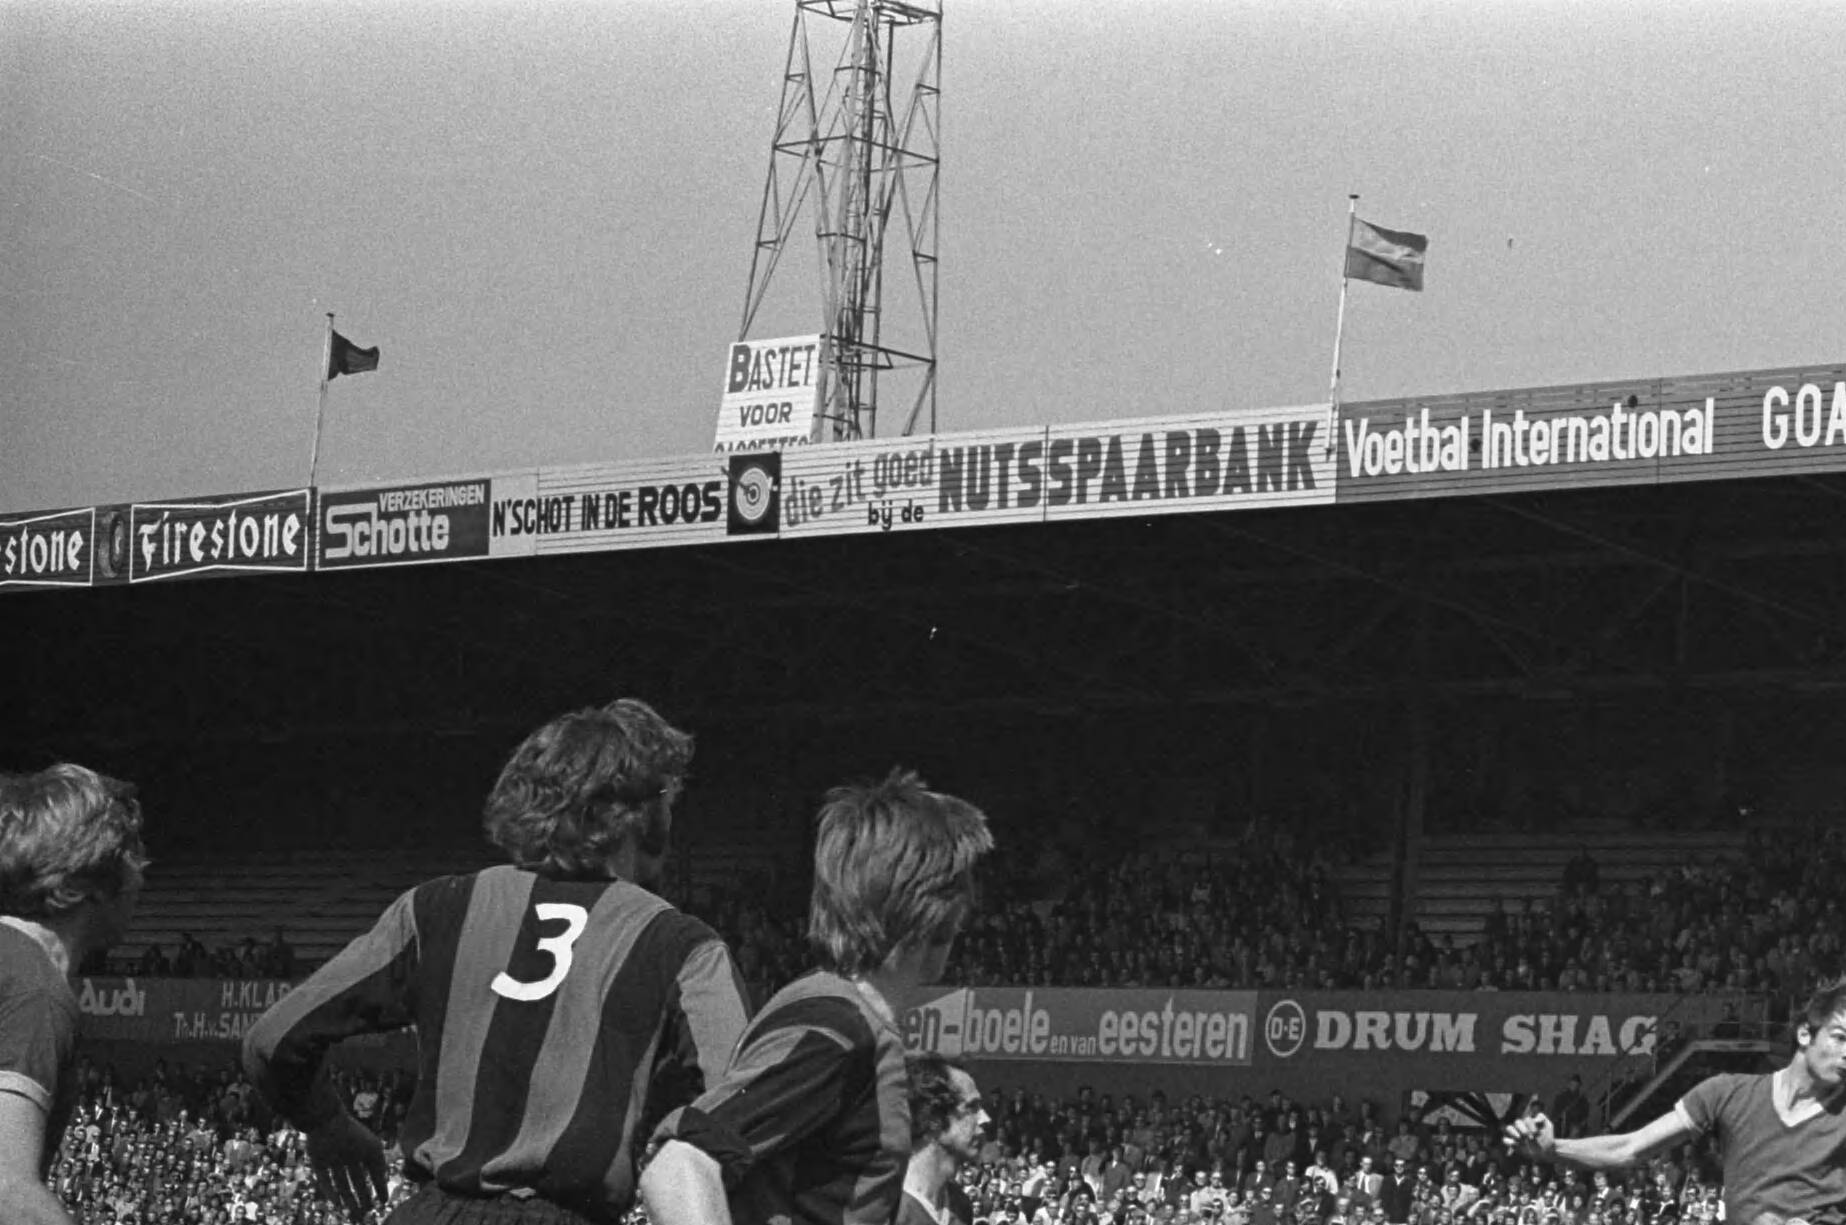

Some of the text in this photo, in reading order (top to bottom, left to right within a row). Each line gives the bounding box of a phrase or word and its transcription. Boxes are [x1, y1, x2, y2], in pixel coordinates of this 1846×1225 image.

[728, 344, 816, 393] BASTET
[740, 402, 792, 427] VOOR
[1345, 408, 1469, 477] Voetbal
[1482, 397, 1714, 469] International
[378, 484, 486, 510] VERZEKERINGEN
[785, 420, 1318, 527] die zit goed NUTSSPAARBANK
[325, 502, 450, 559] Schotte
[581, 494, 600, 531] IN
[605, 491, 632, 528] DE
[637, 481, 722, 527] ROOS
[901, 500, 924, 523] de
[5, 526, 84, 575] stone
[138, 509, 301, 572] Firestone
[491, 903, 589, 1001] 3
[1070, 1036, 1096, 1057] van
[1099, 997, 1249, 1060] eesteren
[1313, 1011, 1658, 1054] DRUM SHAG
